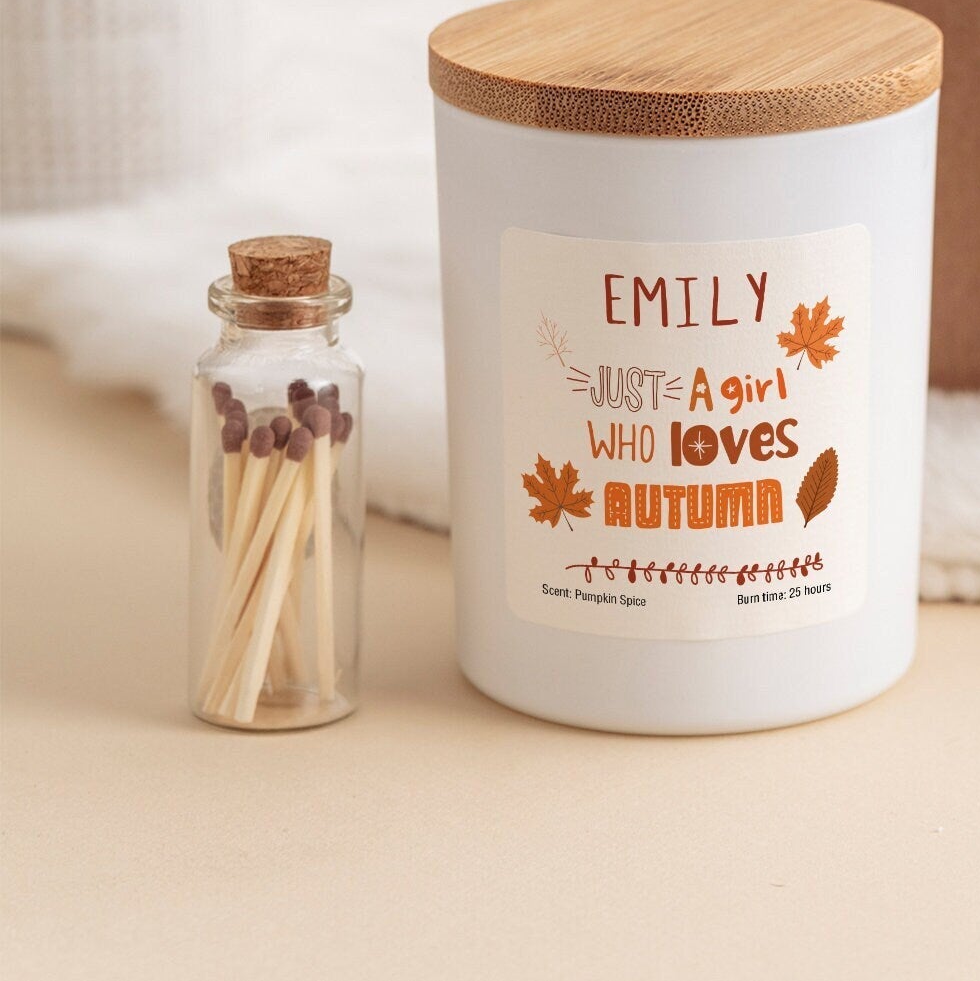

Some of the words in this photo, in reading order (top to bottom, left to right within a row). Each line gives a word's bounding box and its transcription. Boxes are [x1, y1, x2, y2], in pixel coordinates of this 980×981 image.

[604, 271, 768, 328] EMILY
[590, 365, 666, 413] JUST
[689, 366, 714, 412] A
[720, 367, 788, 415] girl
[587, 420, 656, 463] WHO
[670, 418, 799, 467] loves
[604, 478, 784, 530] AUTUMN
[542, 583, 573, 599] Scent:
[575, 588, 617, 605] Pumpkin
[619, 594, 647, 608] Spice
[737, 594, 760, 605] Burn
[762, 590, 787, 603] time:
[789, 586, 801, 599] 25
[804, 582, 832, 596] hours
